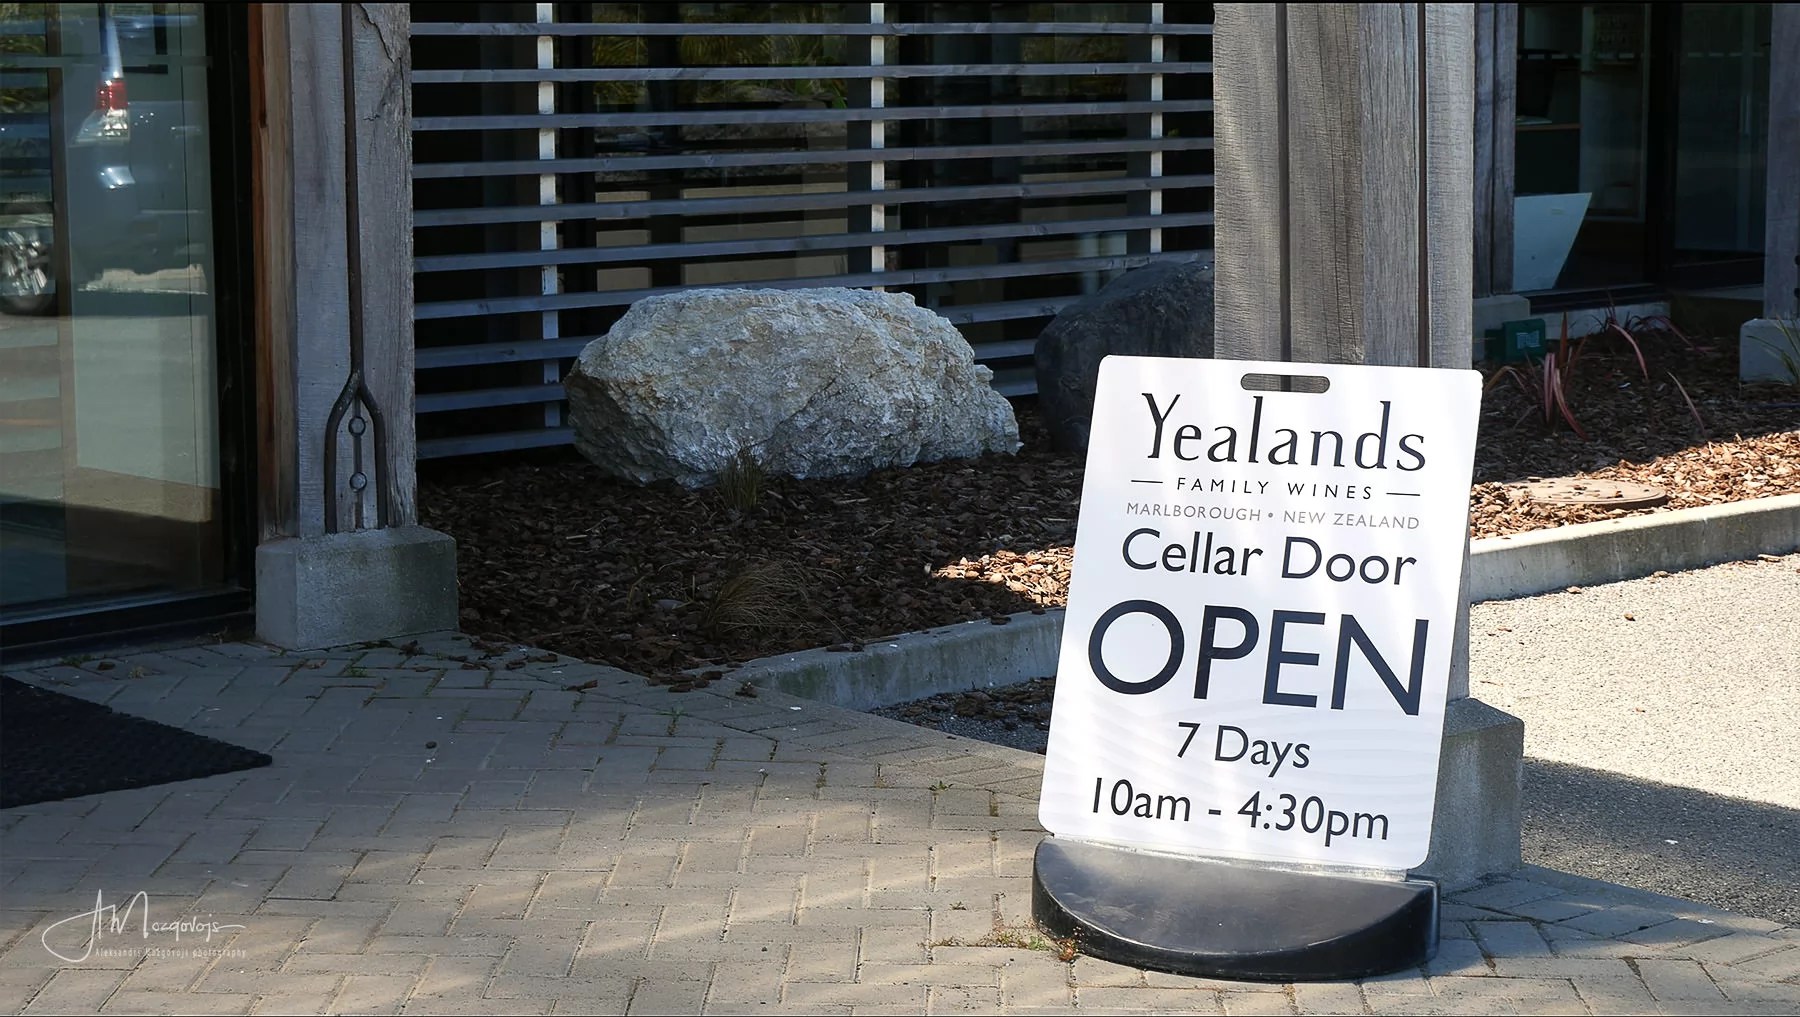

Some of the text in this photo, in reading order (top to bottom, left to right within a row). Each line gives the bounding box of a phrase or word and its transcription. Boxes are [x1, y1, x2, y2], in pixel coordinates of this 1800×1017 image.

[1141, 392, 1426, 472] Yealands
[1126, 502, 1420, 530] MARLBOROUGH NEW ZEALAND
[1176, 476, 1373, 500] FAMILY WINES
[1121, 527, 1418, 586] Cellar Door
[1087, 599, 1430, 717] OPEN
[1176, 721, 1311, 779] 7 Days
[1092, 776, 1191, 822] 10am
[1236, 790, 1389, 848] 4:30pm
